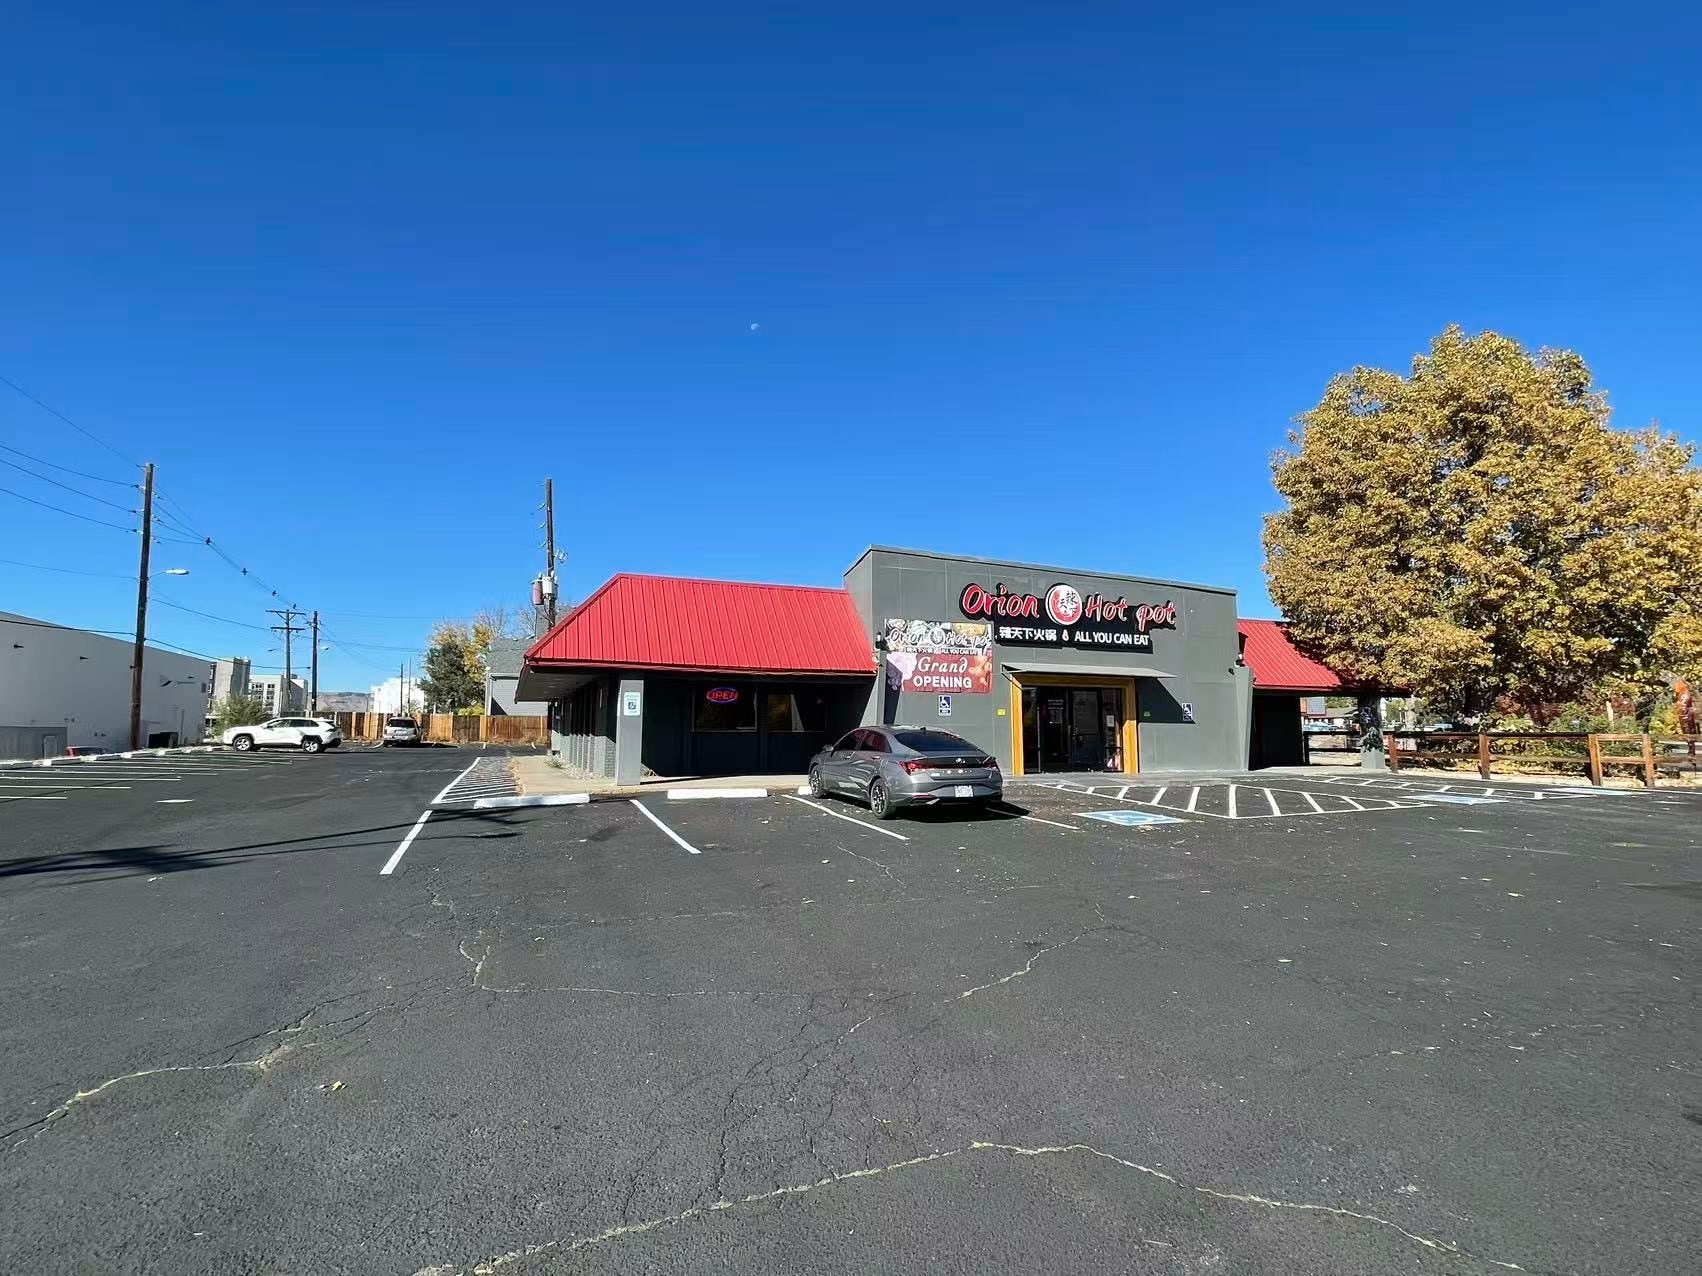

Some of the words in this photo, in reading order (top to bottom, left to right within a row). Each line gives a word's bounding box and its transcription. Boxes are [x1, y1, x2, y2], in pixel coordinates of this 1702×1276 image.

[963, 584, 1040, 618] Orion
[1085, 593, 1128, 622] Hot
[1136, 601, 1176, 632] pot
[1074, 630, 1092, 642] ALL
[1093, 631, 1112, 644] YOU
[1114, 633, 1132, 645] CAN
[1134, 634, 1150, 646] EAT
[917, 656, 968, 673] Grand
[913, 675, 972, 689] OPENING
